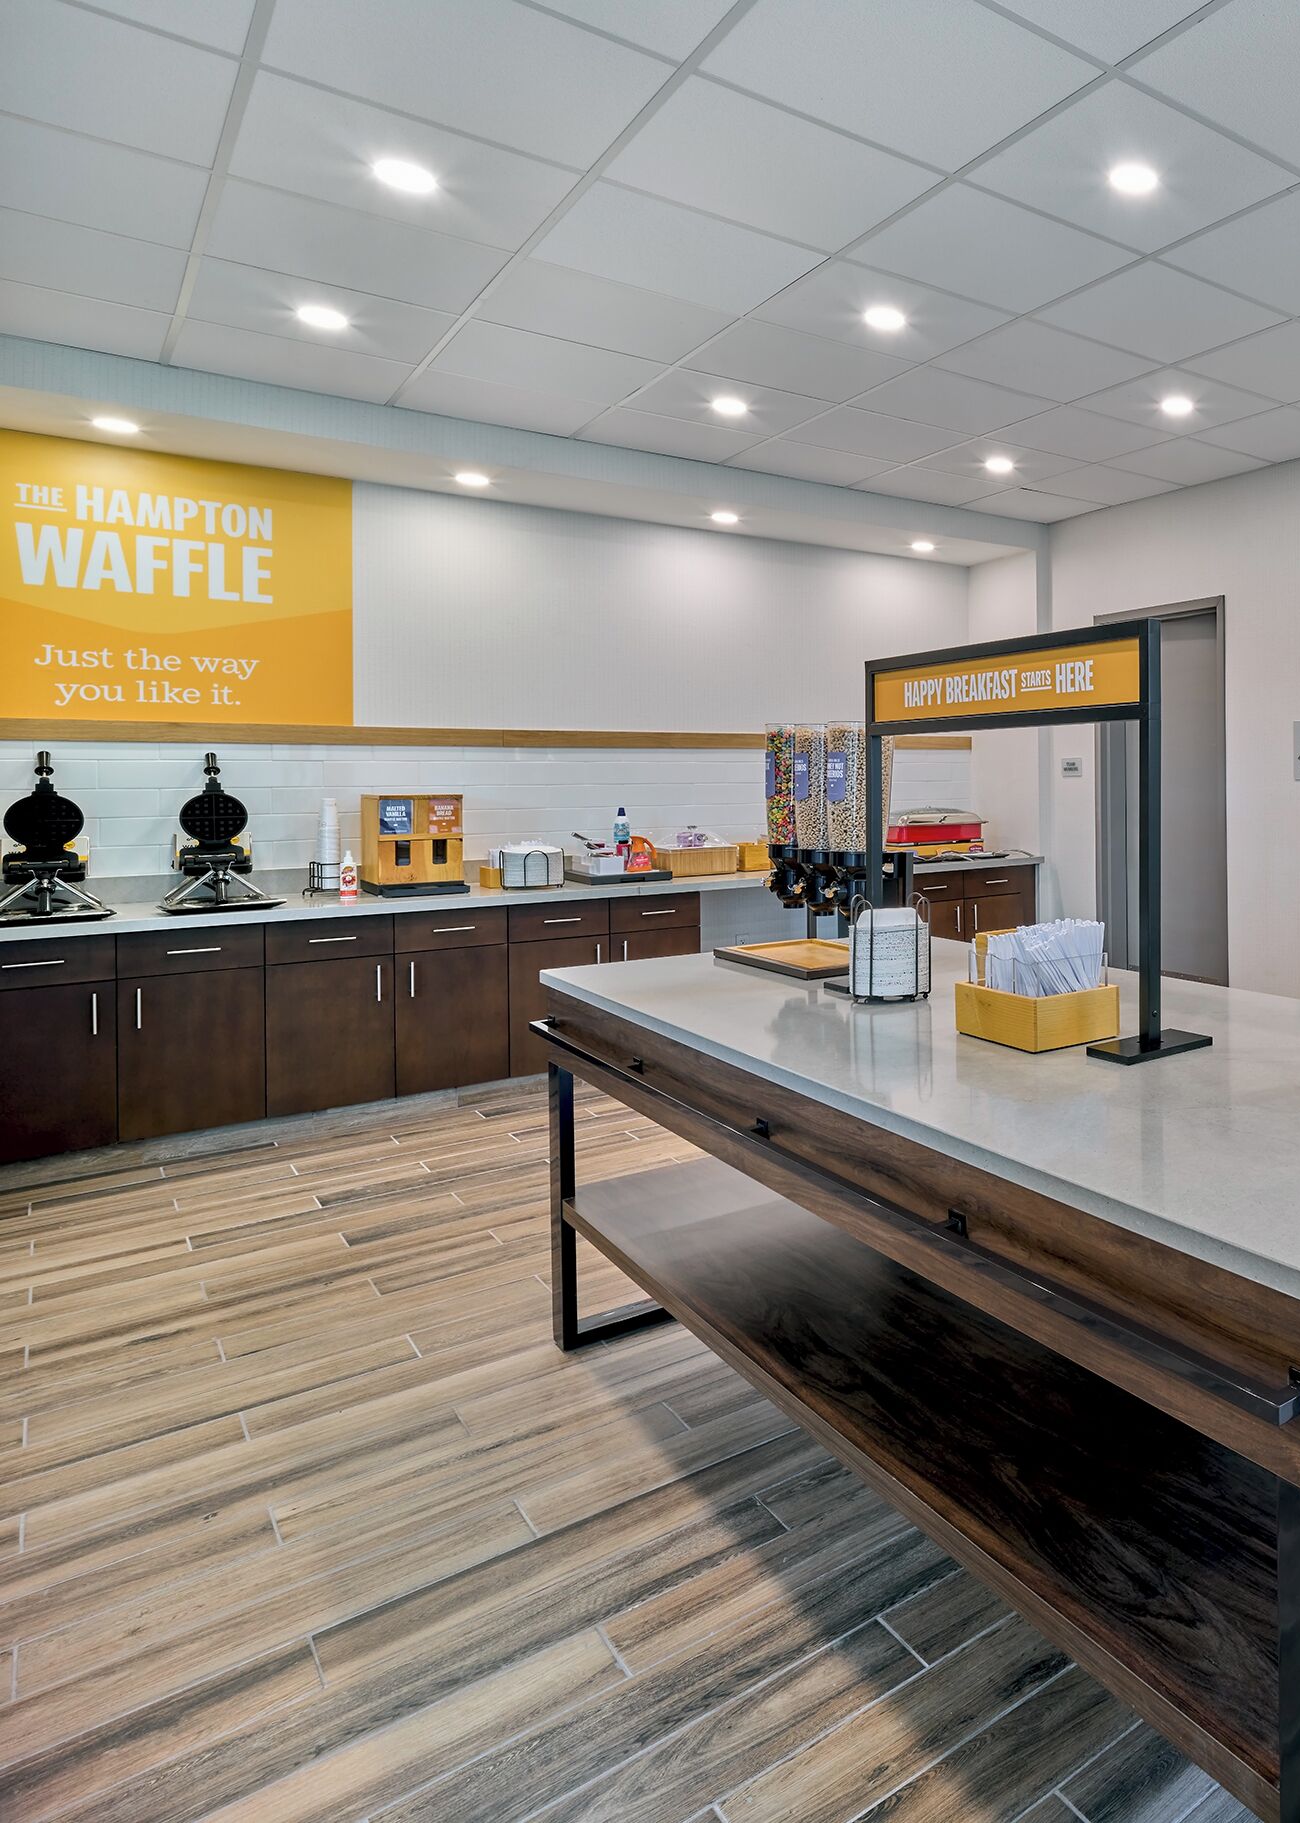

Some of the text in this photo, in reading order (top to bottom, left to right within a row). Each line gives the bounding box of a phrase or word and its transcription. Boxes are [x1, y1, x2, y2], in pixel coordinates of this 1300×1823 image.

[14, 483, 273, 541] THE HAMPTON
[14, 521, 273, 604] WAFFLE
[34, 644, 261, 681] Just the way
[904, 659, 1095, 708] HAPPY BREAKFAST STARTS HERE
[54, 680, 242, 707] you like it.
